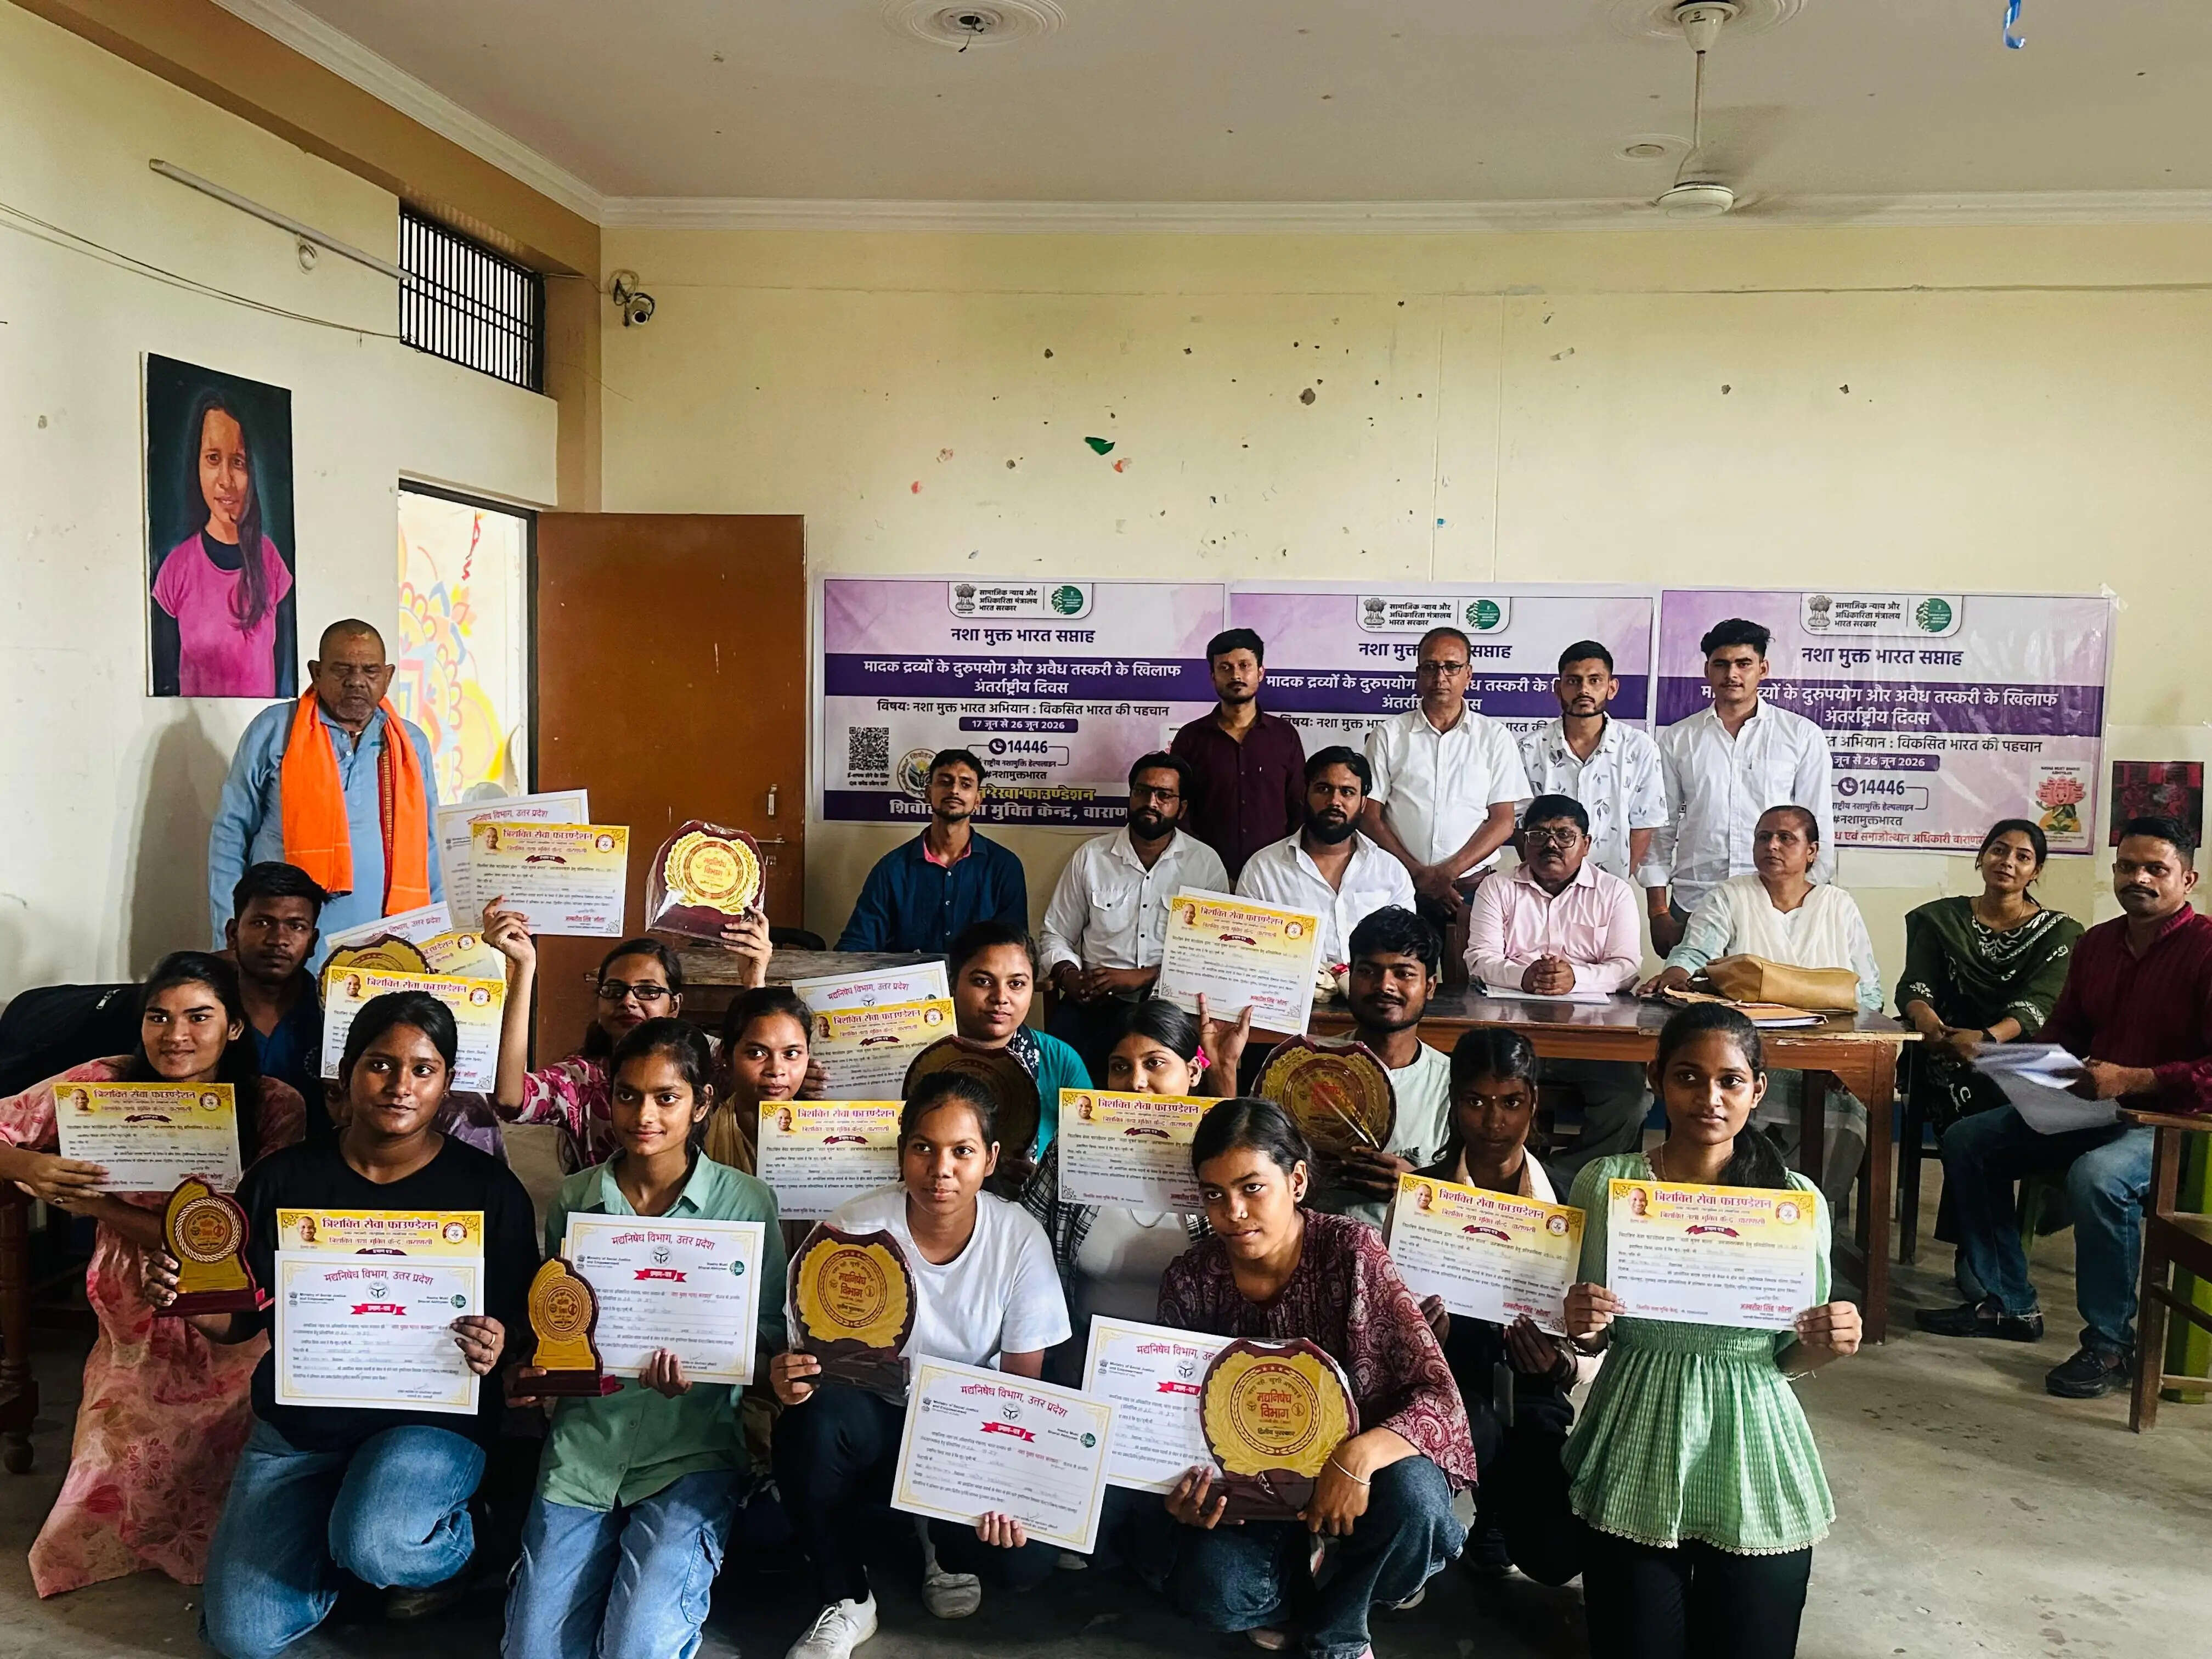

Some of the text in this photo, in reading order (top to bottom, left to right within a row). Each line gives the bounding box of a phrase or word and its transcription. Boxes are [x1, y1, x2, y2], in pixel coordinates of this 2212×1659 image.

[1836, 601, 1867, 610] सामाजिक
[1888, 601, 1900, 610] और
[1835, 610, 1900, 619] अधिकारिता मंत्रालय
[951, 629, 1096, 646] नशा मुक्त भारत सप्ताह
[1358, 643, 1389, 656] नशा
[1802, 648, 1963, 668] नशा मुक्त भारत सप्ताह
[864, 659, 1182, 678] मादक द्रव्यों के दुरुपयोग और अवैध तस्करी के खिलाफ
[1034, 679, 1069, 693] दिवस
[1266, 674, 1548, 693] मादक द्रव्यों के दुरुपयोग तस्करी के
[1783, 684, 2058, 706] के दुरुपयोग और अवैध तस्करी के खिलाफ
[913, 701, 1170, 716] नशा मुक्त भारत अभियान विकसित भारत की पहचान
[1891, 707, 1931, 725] दिवस
[984, 720, 998, 730] जून
[1000, 719, 1008, 729] से
[1025, 721, 1039, 731] जून
[1317, 719, 1363, 731] नशा मुक्त
[1007, 740, 1048, 754] 14446
[1840, 733, 2043, 753] अभियान विकसित भारत की पहचान
[1833, 754, 1925, 769] जून से 26 जून 2026
[1860, 780, 1905, 795] 14446
[991, 802, 1034, 820] मुक्ति
[1845, 831, 1858, 840] एवं
[1913, 832, 1950, 844] अधिकारी
[364, 1218, 383, 1229] सेवा
[696, 1237, 715, 1251] प्रदेश
[413, 1272, 433, 1285] प्रदेश
[1047, 1400, 1068, 1418] प्रदेश
[1261, 1403, 1289, 1419] विभाग
